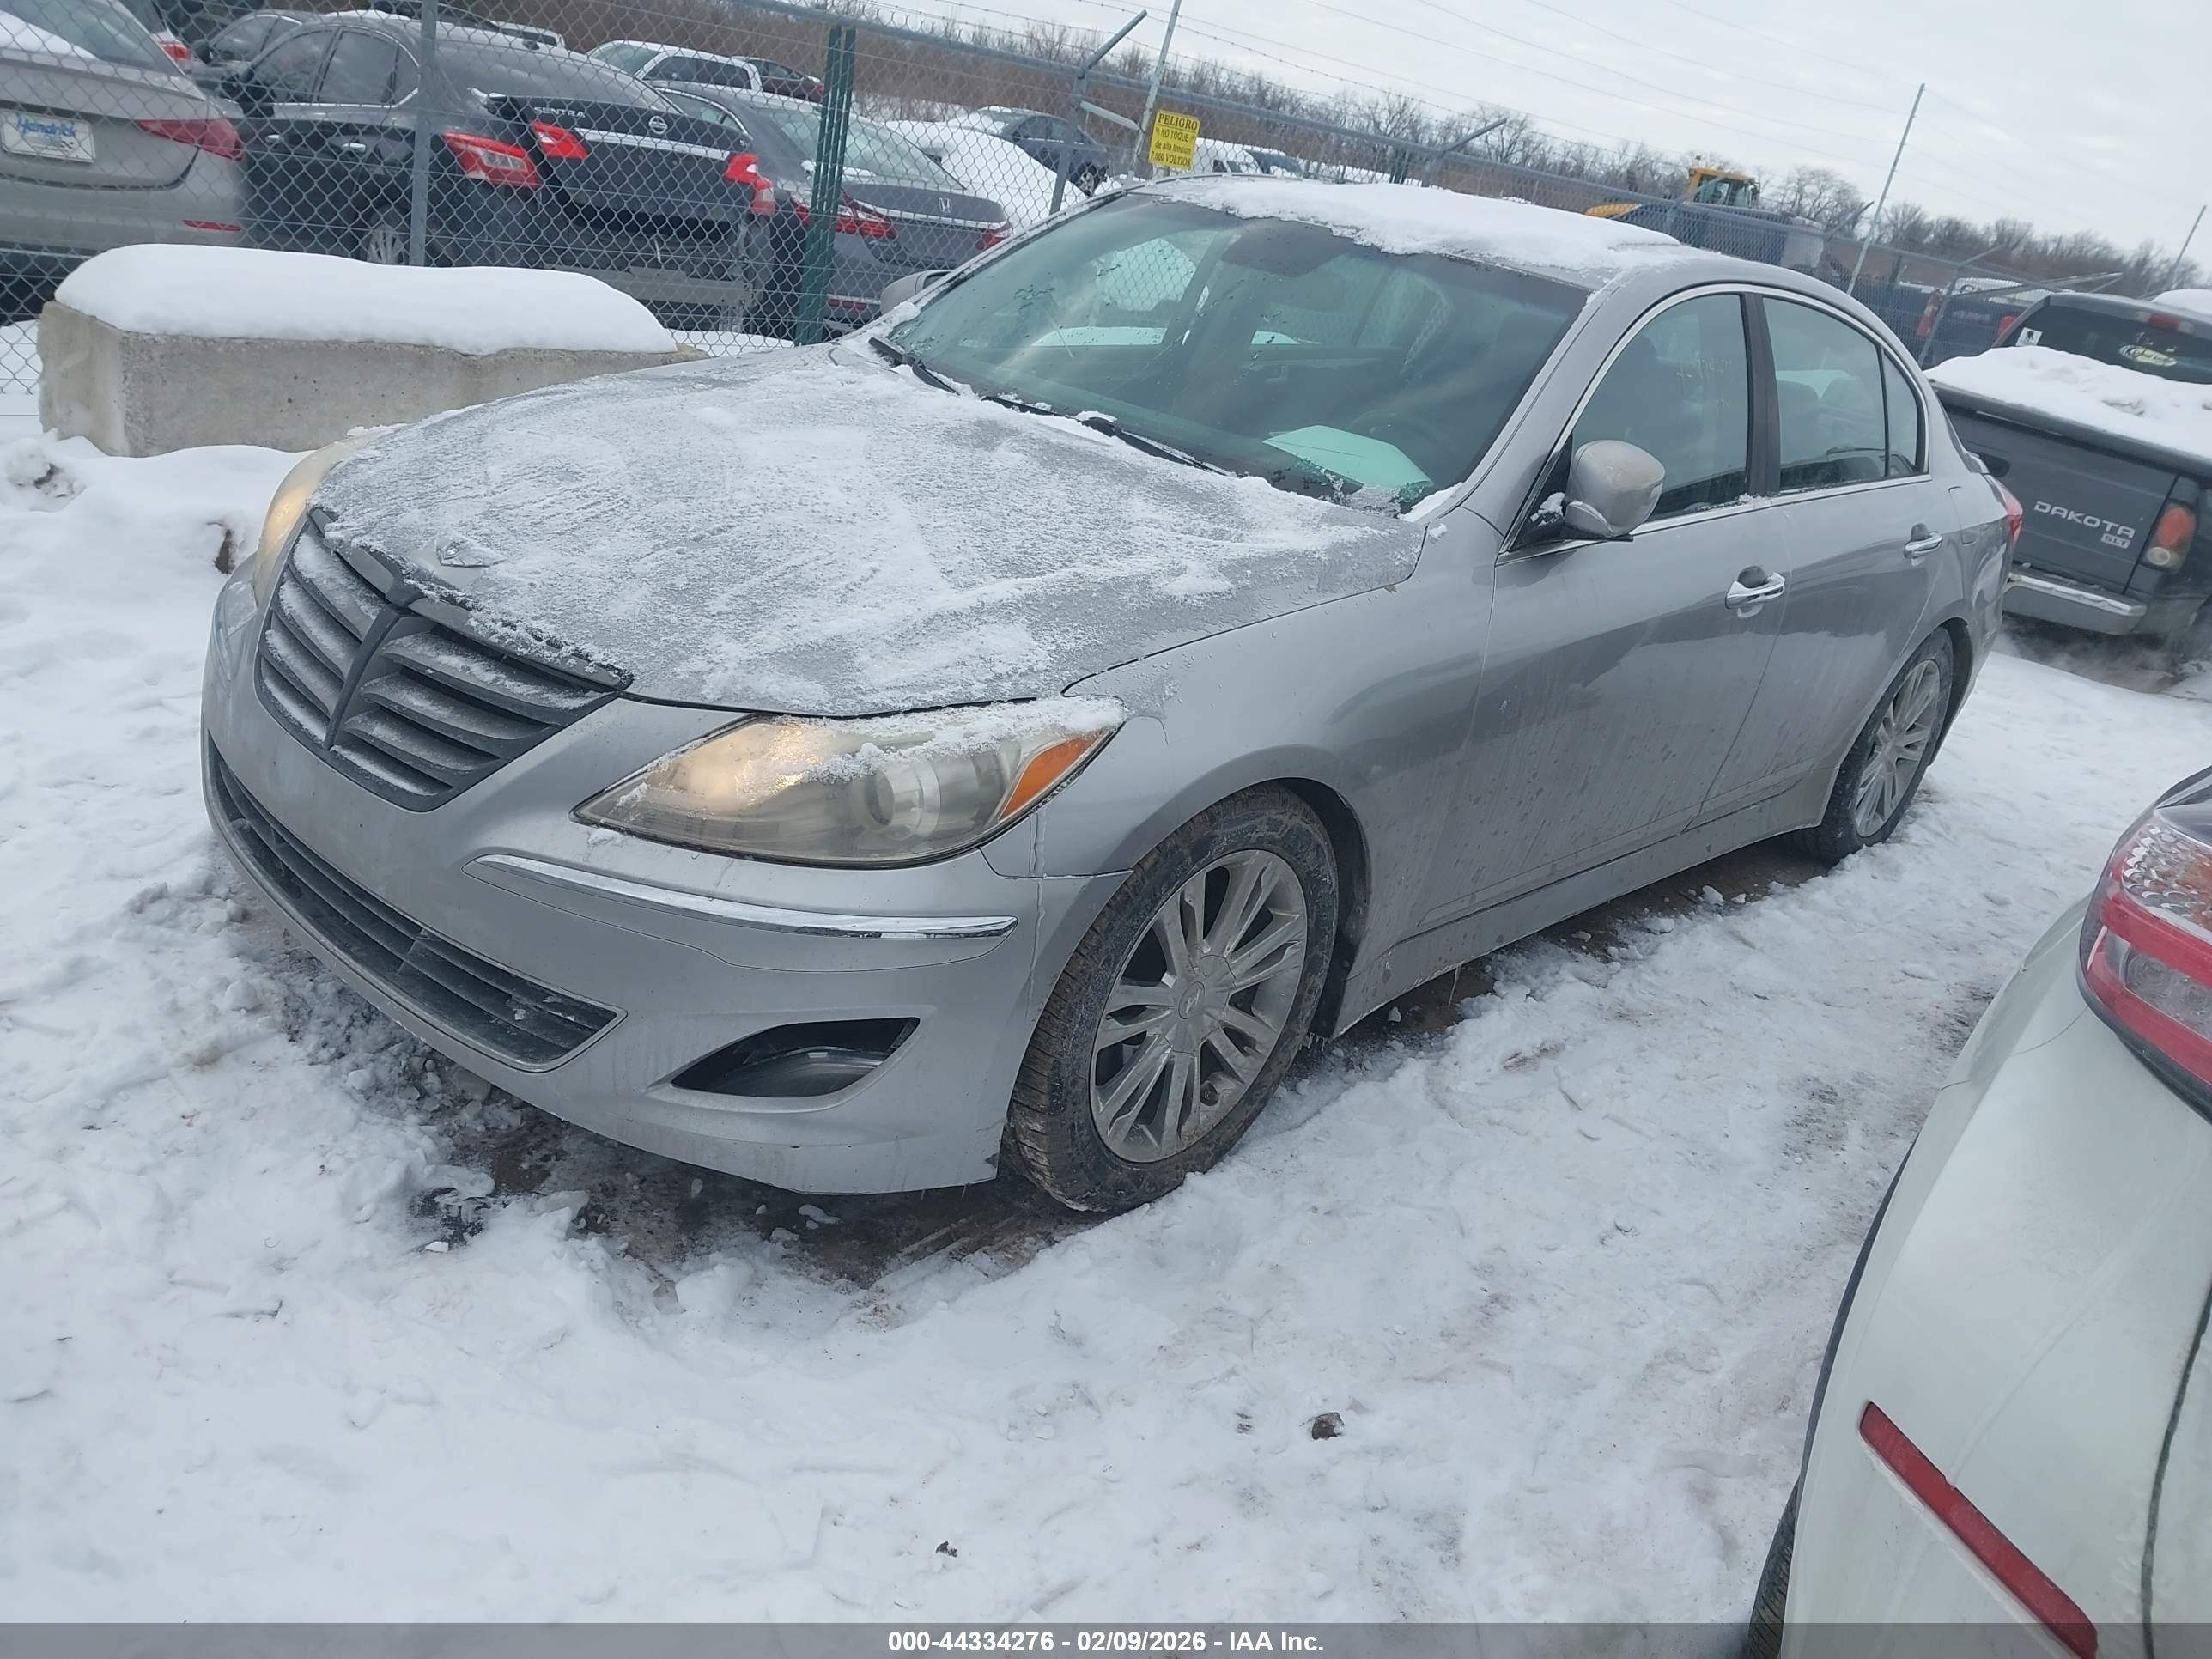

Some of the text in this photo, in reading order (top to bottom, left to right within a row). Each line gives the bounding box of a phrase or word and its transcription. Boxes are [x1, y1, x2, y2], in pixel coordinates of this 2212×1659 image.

[534, 106, 586, 118] SENTRA
[1158, 113, 1198, 131] PELIGRO
[1161, 128, 1189, 143] NO TOQUE
[1154, 140, 1162, 149] de
[2033, 501, 2136, 538] DAKOTA
